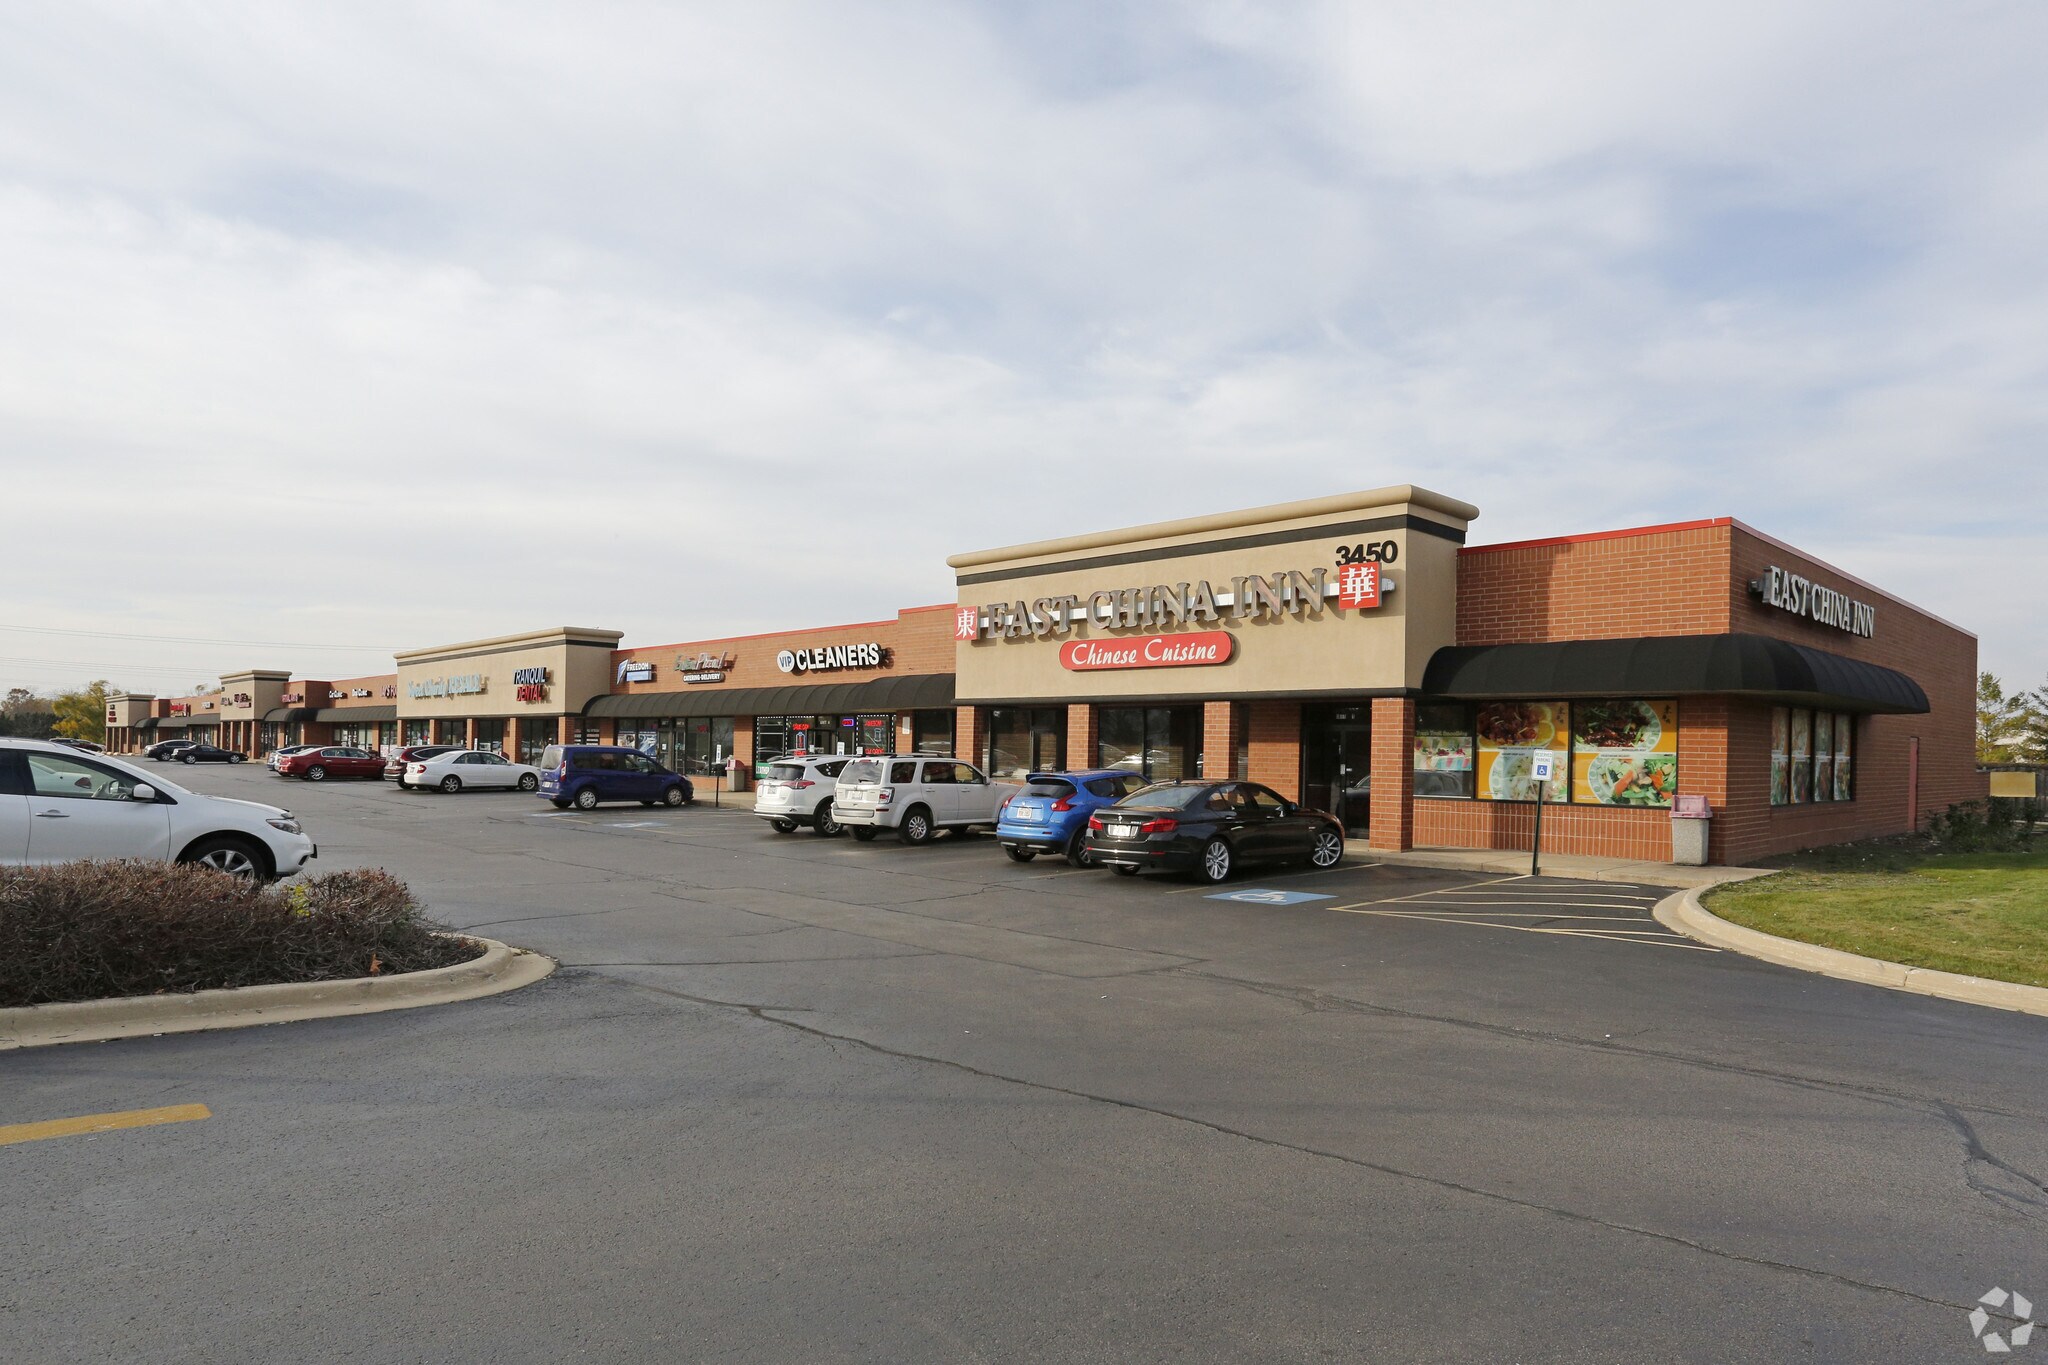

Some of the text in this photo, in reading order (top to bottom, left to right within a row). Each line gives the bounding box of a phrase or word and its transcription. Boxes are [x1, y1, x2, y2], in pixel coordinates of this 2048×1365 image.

[1335, 540, 1399, 567] 3450
[1341, 565, 1376, 606] 華
[986, 567, 1328, 639] EAST CHINA INN
[1770, 565, 1875, 639] EAST CHINA INN
[955, 608, 976, 639] 東
[779, 643, 880, 671] VIP CLEANERS
[1071, 638, 1217, 666] Chinese Cuisine
[514, 667, 547, 685] TRANQUIL
[627, 662, 649, 672] FREEDOM
[516, 685, 542, 701] DENTAL
